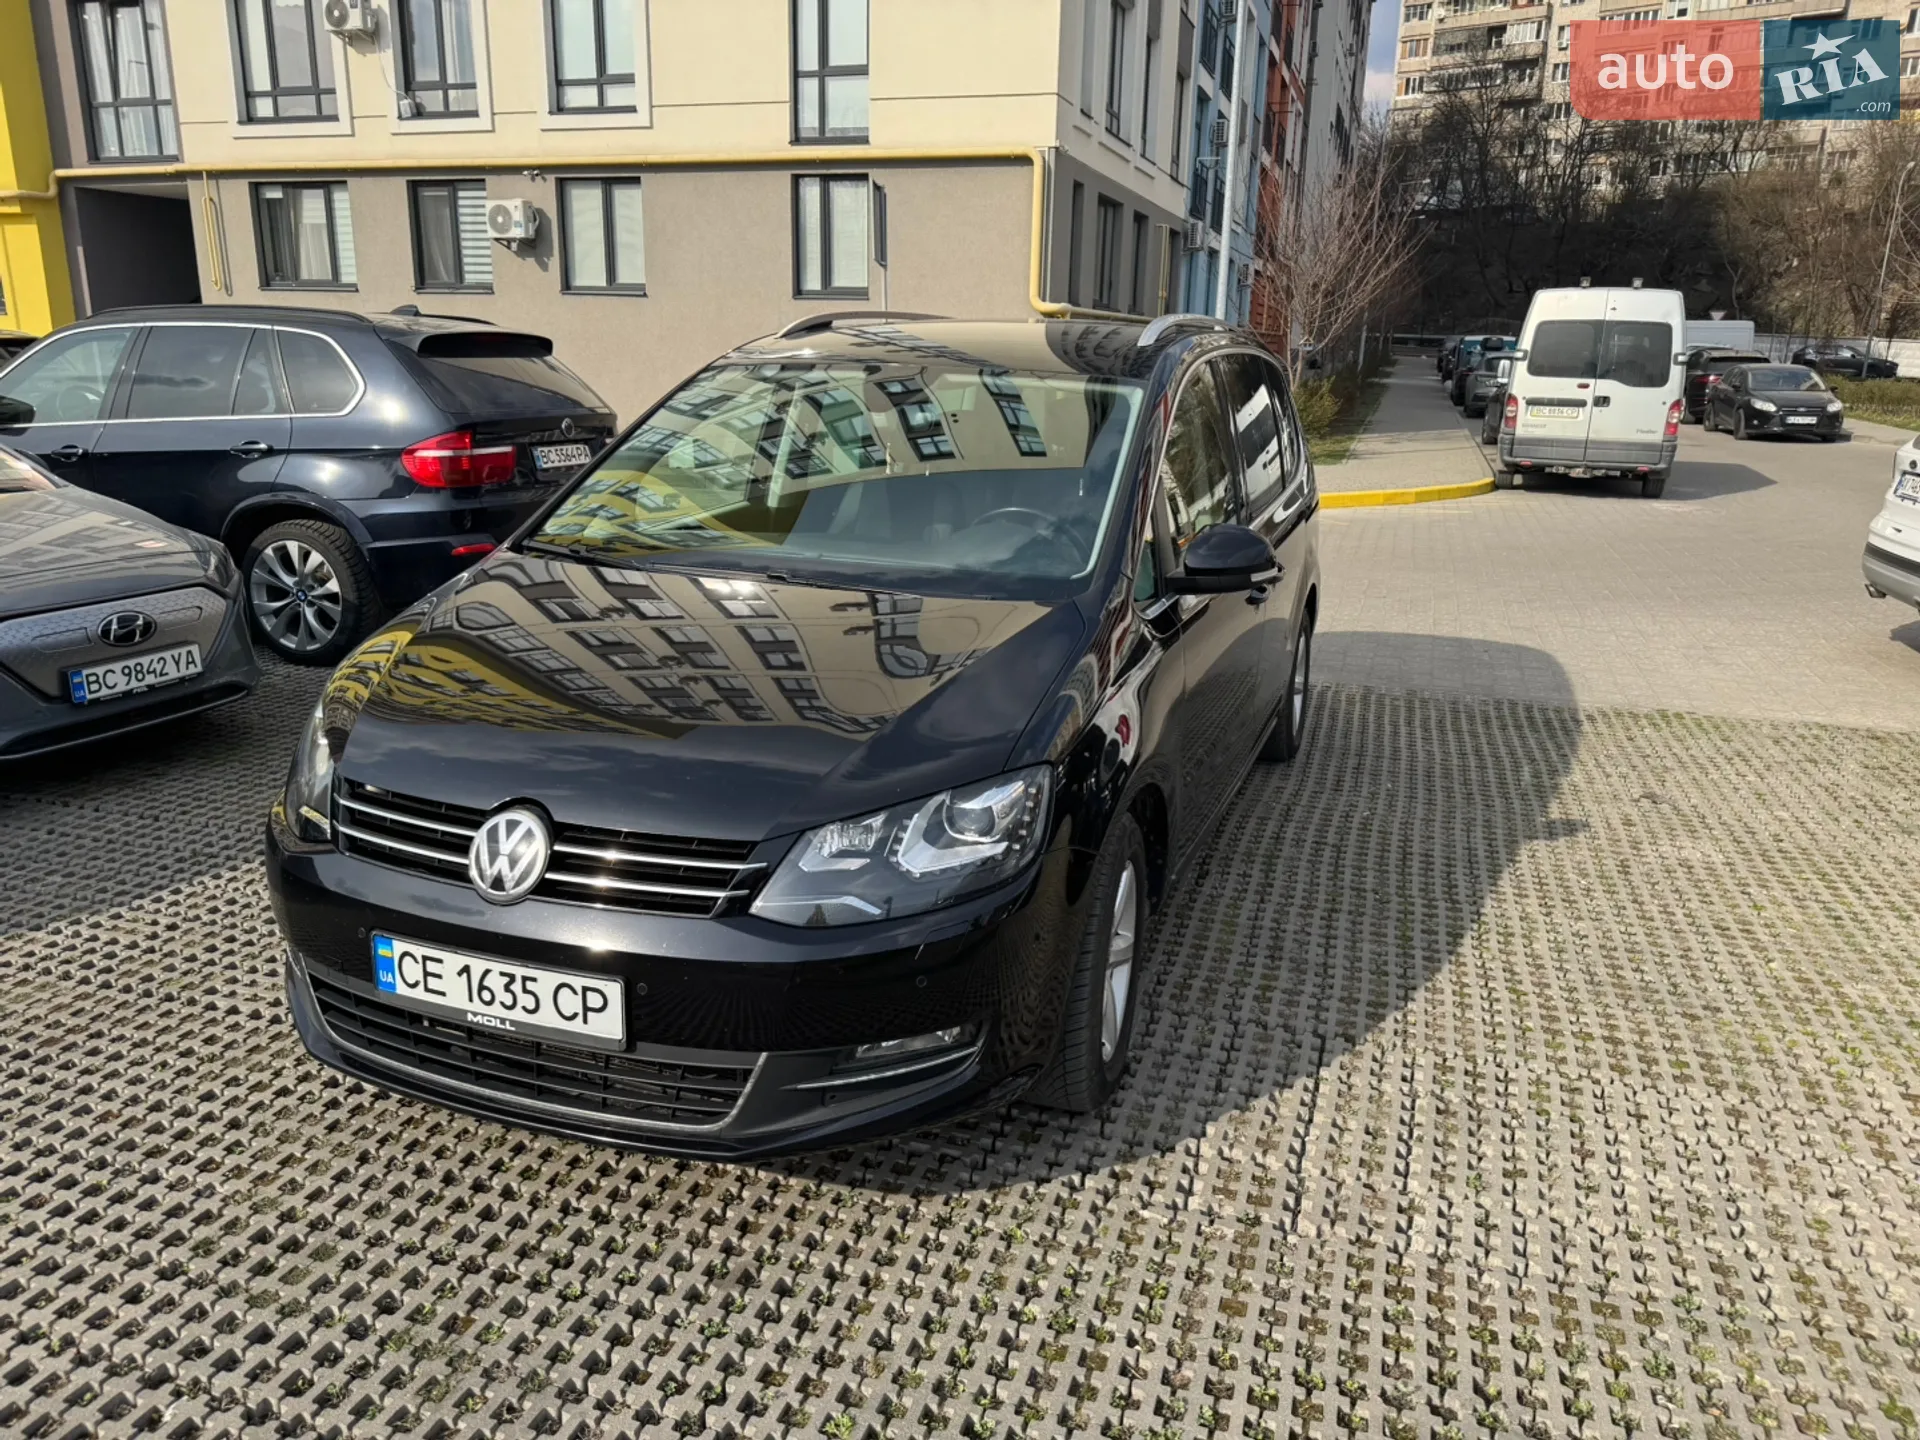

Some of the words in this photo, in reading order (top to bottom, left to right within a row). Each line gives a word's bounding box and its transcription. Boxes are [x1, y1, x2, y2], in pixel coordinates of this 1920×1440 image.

[540, 450, 555, 464] BC
[85, 669, 118, 695] BC
[121, 656, 169, 687] 9842
[170, 649, 197, 673] YA
[379, 969, 395, 985] UA
[398, 950, 447, 997] CE
[456, 964, 541, 1015] 1635
[552, 982, 609, 1025] CP
[466, 1012, 516, 1031] MOLL
